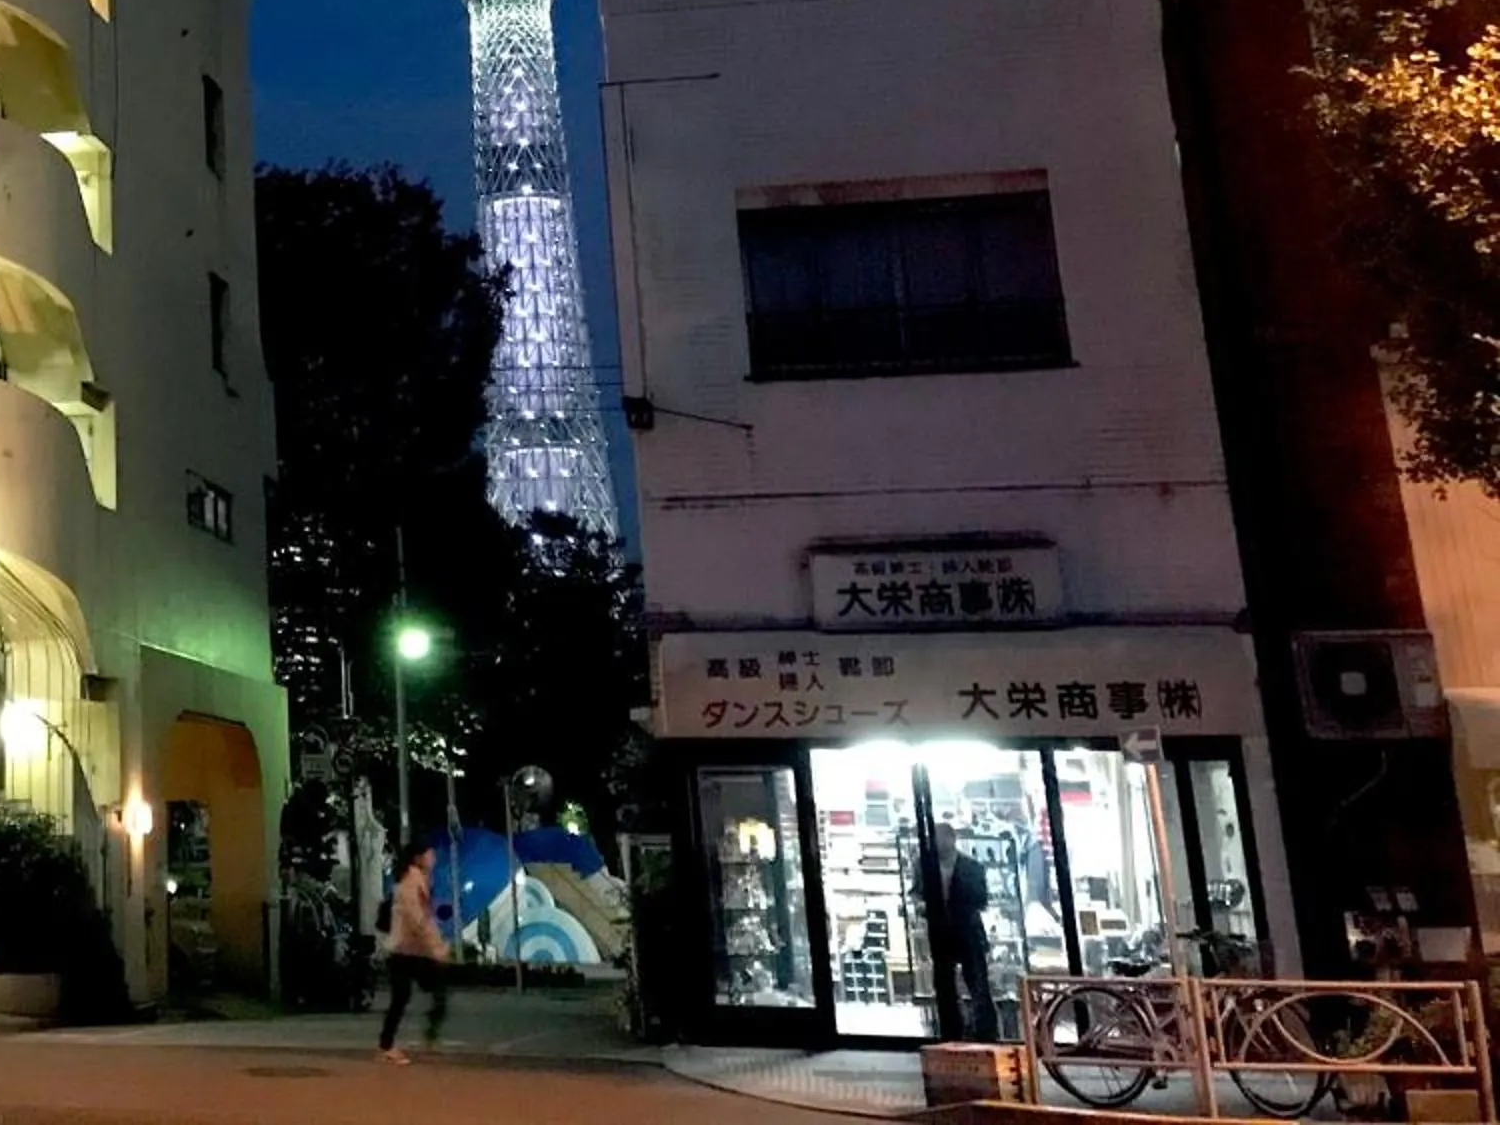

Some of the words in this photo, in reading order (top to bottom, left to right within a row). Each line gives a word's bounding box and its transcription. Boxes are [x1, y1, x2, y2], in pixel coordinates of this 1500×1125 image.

[702, 698, 911, 729] ダンスシューズ
